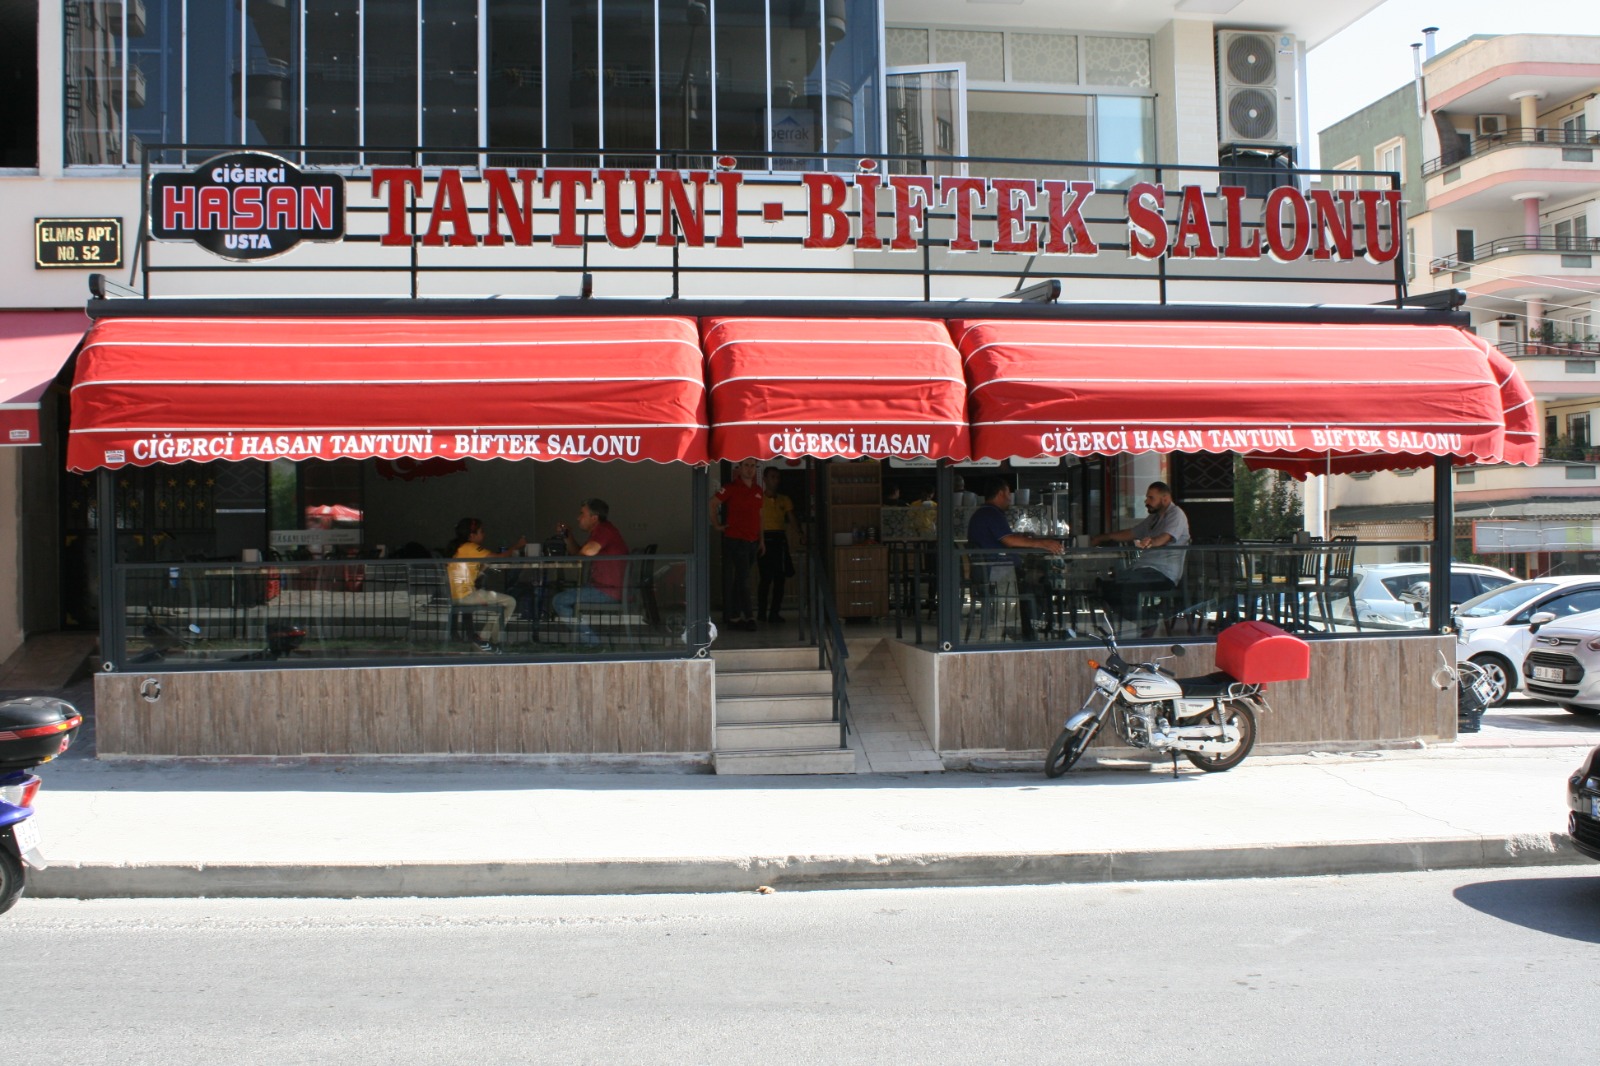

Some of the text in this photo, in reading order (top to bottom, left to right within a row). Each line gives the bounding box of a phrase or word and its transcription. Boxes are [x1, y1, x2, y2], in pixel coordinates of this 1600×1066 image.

[211, 163, 286, 183] CİĞERCİ
[162, 186, 334, 231] HASAN
[372, 156, 744, 249] TANTUNİ
[802, 157, 1098, 254] BİFTEK
[1126, 186, 1401, 262] SALONU
[41, 227, 115, 242] ELMAS APT.
[224, 234, 271, 250] USTA
[57, 245, 100, 261] NO. 52
[132, 432, 235, 461] CİĞERCİ
[240, 435, 323, 455] HASAN
[329, 429, 434, 455] TANTUNİ
[454, 429, 541, 455] BİFTEK
[547, 435, 641, 456] SALONU
[769, 427, 931, 455] CİĞERCİ HASAN
[1040, 424, 1462, 453] CİĞERCİ HASAN TANTUNİ BİFTEK SALONU
